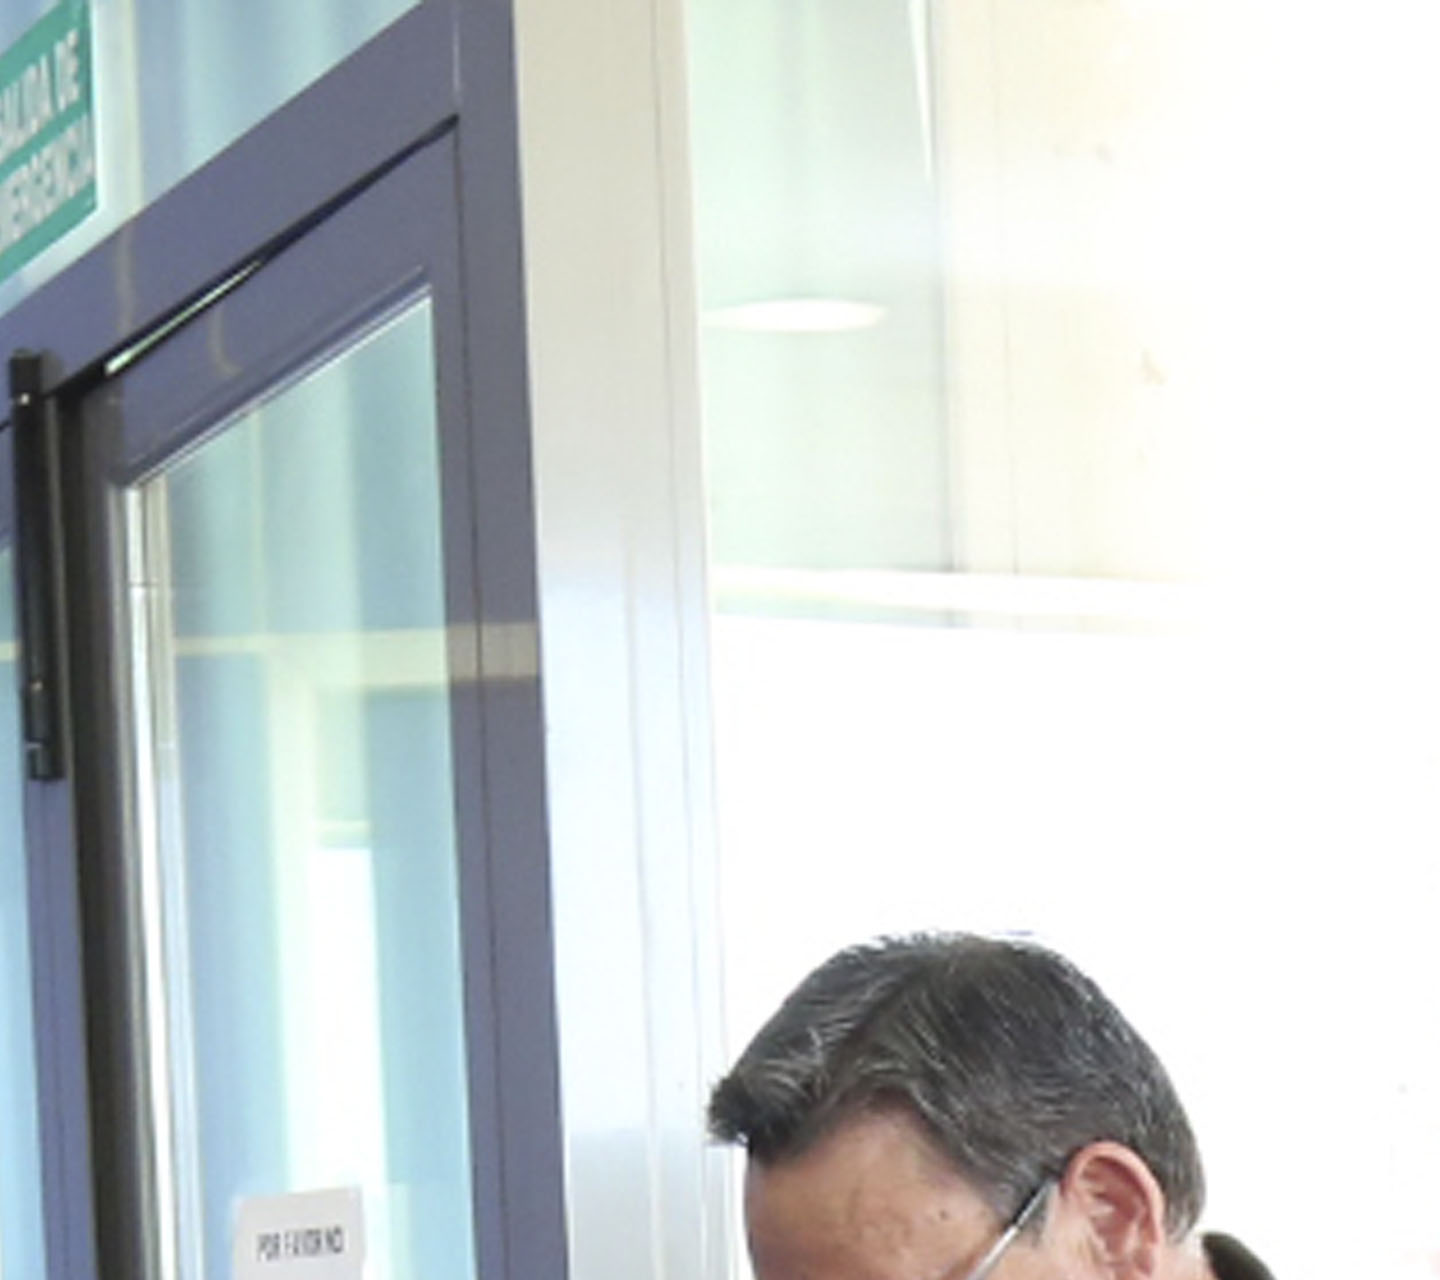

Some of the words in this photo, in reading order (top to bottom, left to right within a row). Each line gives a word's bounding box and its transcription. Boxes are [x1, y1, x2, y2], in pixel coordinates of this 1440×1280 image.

[54, 27, 80, 112] DE
[257, 1232, 280, 1262] POR
[325, 1226, 344, 1255] NO
